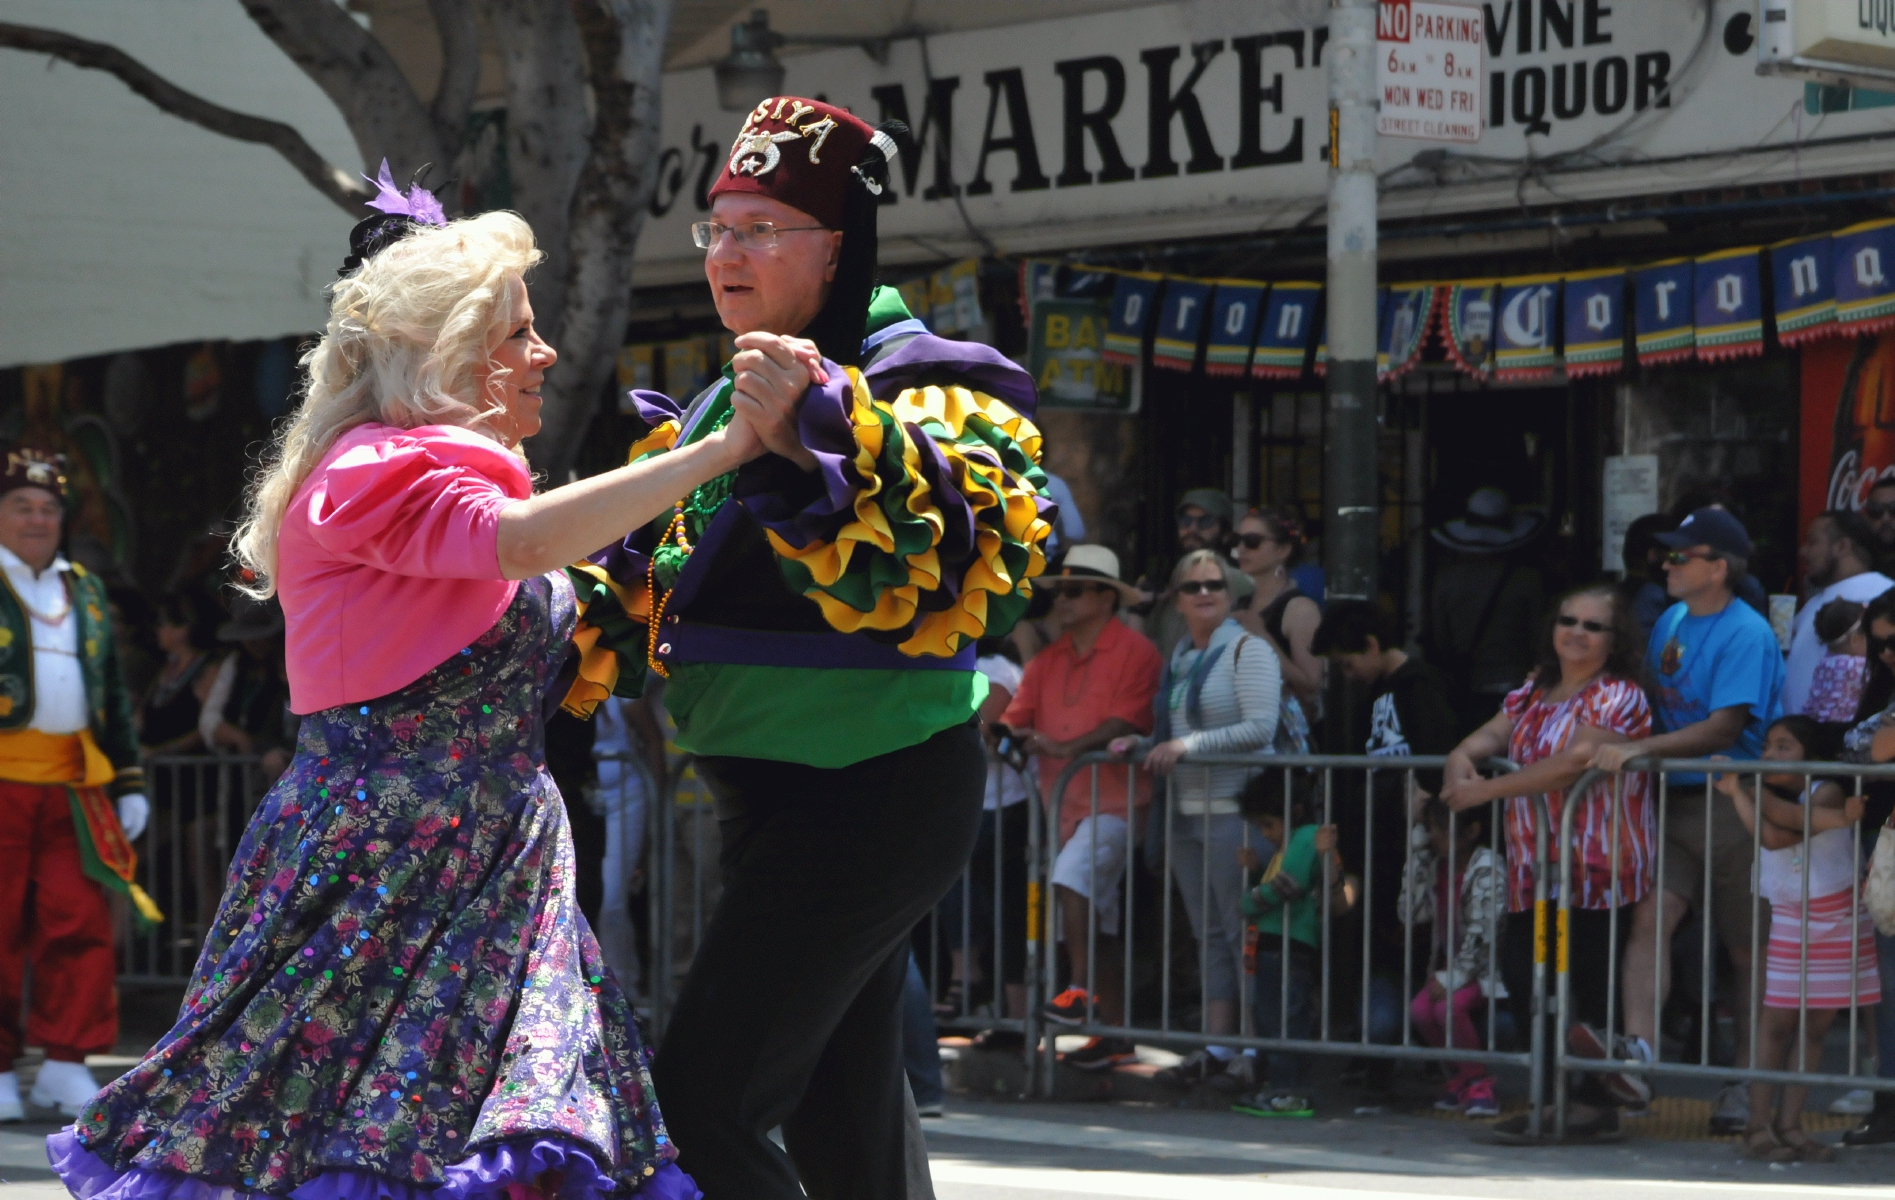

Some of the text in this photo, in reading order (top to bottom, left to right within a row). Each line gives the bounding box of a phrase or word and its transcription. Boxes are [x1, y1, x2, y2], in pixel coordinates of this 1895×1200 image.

[1380, 1, 1479, 44] NO PARKING
[1384, 85, 1473, 112] MON WED FRI
[1481, 51, 1671, 136] IQUOR
[872, 26, 1328, 205] MARKE
[1381, 117, 1475, 138] STREET CLEANING
[1502, 245, 1886, 351] Corona
[1045, 314, 1108, 348] BA
[1040, 358, 1124, 394] ATM
[1826, 449, 1895, 512] Coc
